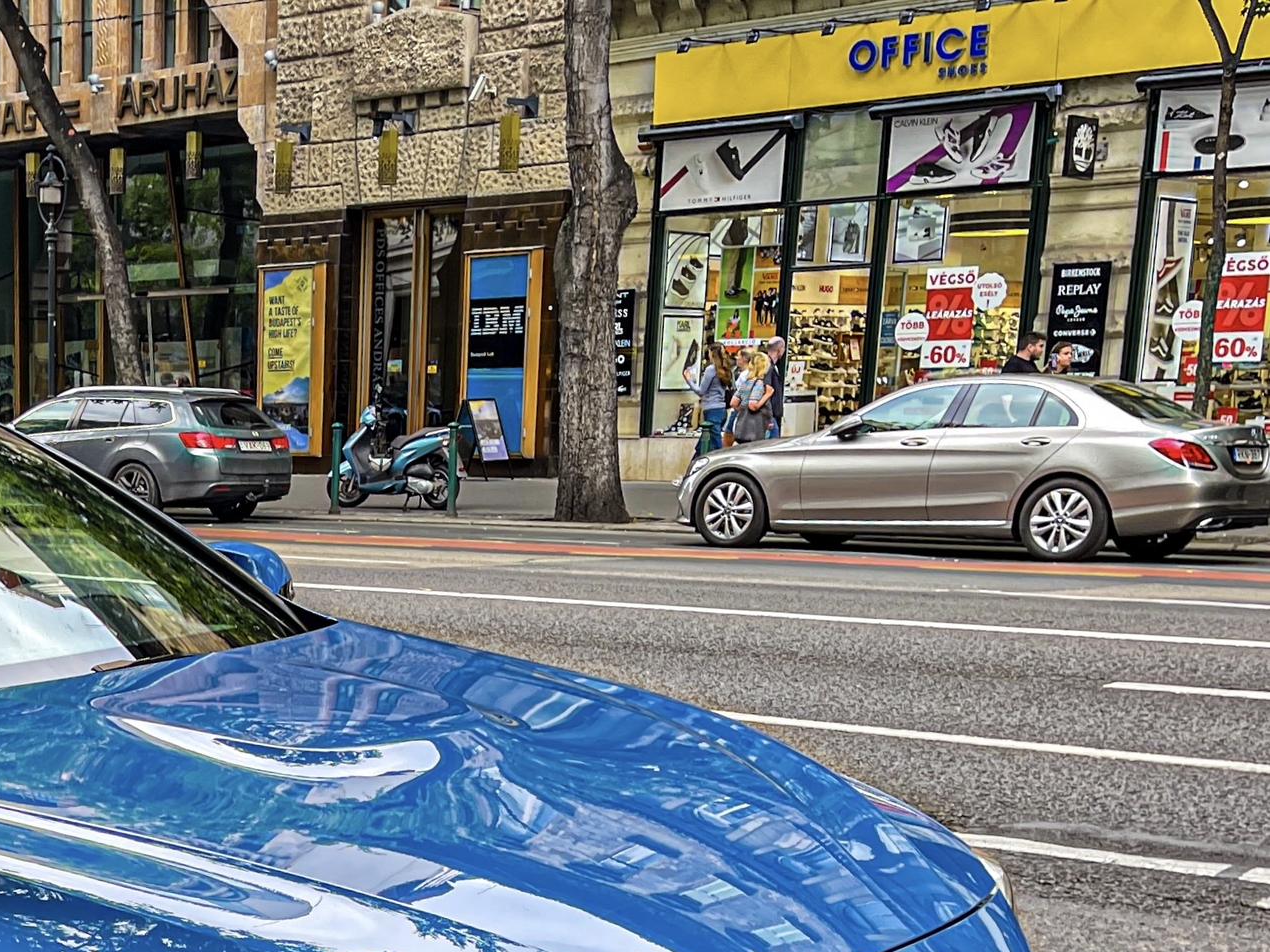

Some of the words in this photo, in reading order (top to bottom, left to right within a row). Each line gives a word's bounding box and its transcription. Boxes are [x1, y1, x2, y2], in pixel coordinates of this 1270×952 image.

[848, 24, 990, 72] OFFICE
[938, 63, 987, 79] SHOES
[894, 118, 919, 128] CALVIN
[920, 117, 939, 125] KLEIN
[722, 194, 751, 202] HILFIGER
[1226, 255, 1269, 272] ÉGSŐ
[929, 270, 975, 286] VÉGSŐ
[1061, 267, 1101, 278] BIRKENSTOCK
[375, 261, 385, 325] OFFICES
[818, 285, 834, 293] HUGO
[1057, 283, 1102, 296] REPLAY
[269, 295, 285, 305] WANT
[1216, 297, 1266, 310] EÁRAZÁS
[268, 307, 273, 316] A
[274, 306, 291, 316] TASTE
[292, 305, 299, 316] OF
[926, 308, 973, 319] LEÁRAZÁS
[1073, 305, 1098, 318] Jeans
[1179, 308, 1200, 319] TÖB
[268, 317, 302, 328] BUDAPEST'S
[470, 305, 524, 336] IBM
[900, 320, 925, 330] TÖBB
[268, 329, 282, 339] HIGH
[282, 329, 298, 338] LIFE?
[1053, 329, 1090, 337] CONVERSE
[268, 347, 283, 357] COME
[1214, 337, 1258, 358] 60%
[923, 345, 967, 364] -60%
[267, 359, 295, 370] UPSTAIRS!
